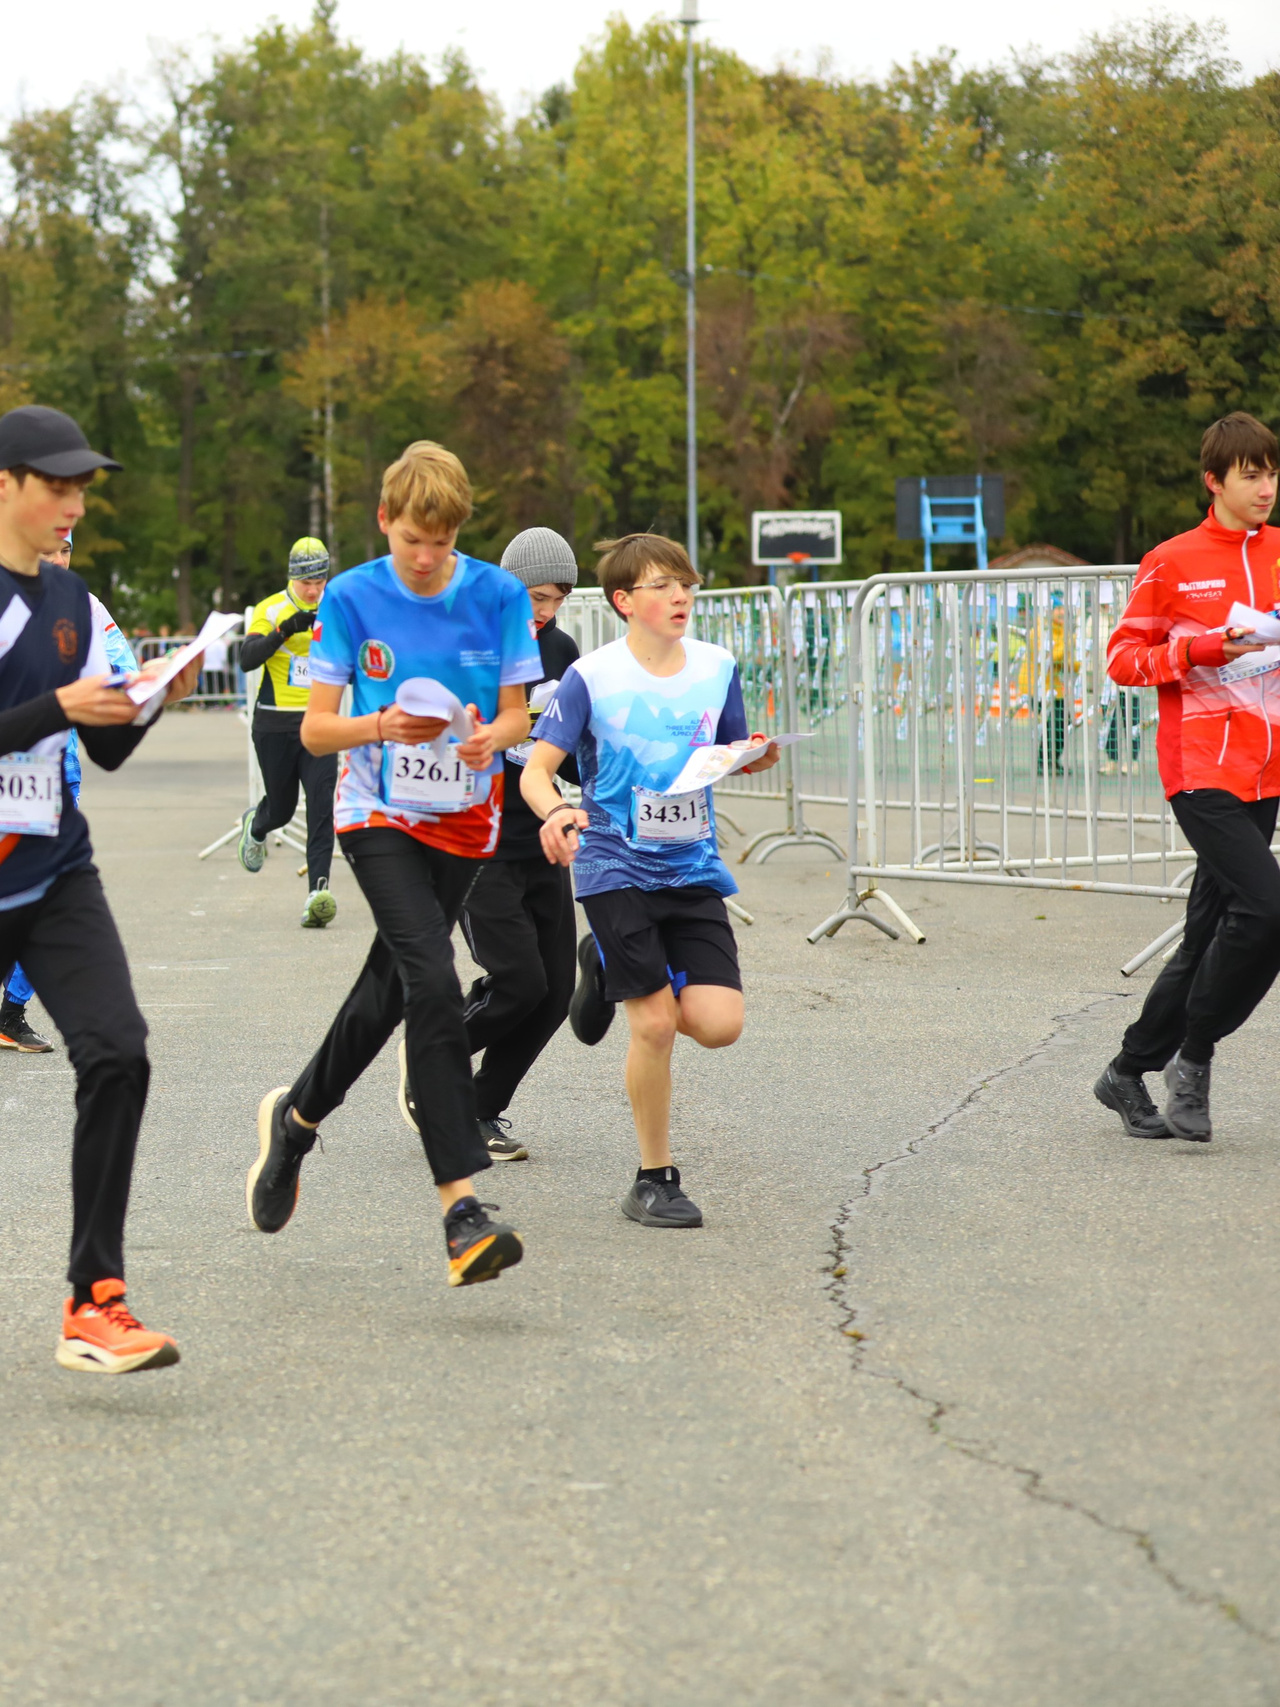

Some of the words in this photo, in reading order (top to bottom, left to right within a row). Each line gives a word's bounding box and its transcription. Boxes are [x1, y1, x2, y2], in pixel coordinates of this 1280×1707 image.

[1178, 579, 1226, 592] ЛЫТКАРИНО
[395, 756, 461, 782] 326.1
[639, 800, 697, 823] 343.1
